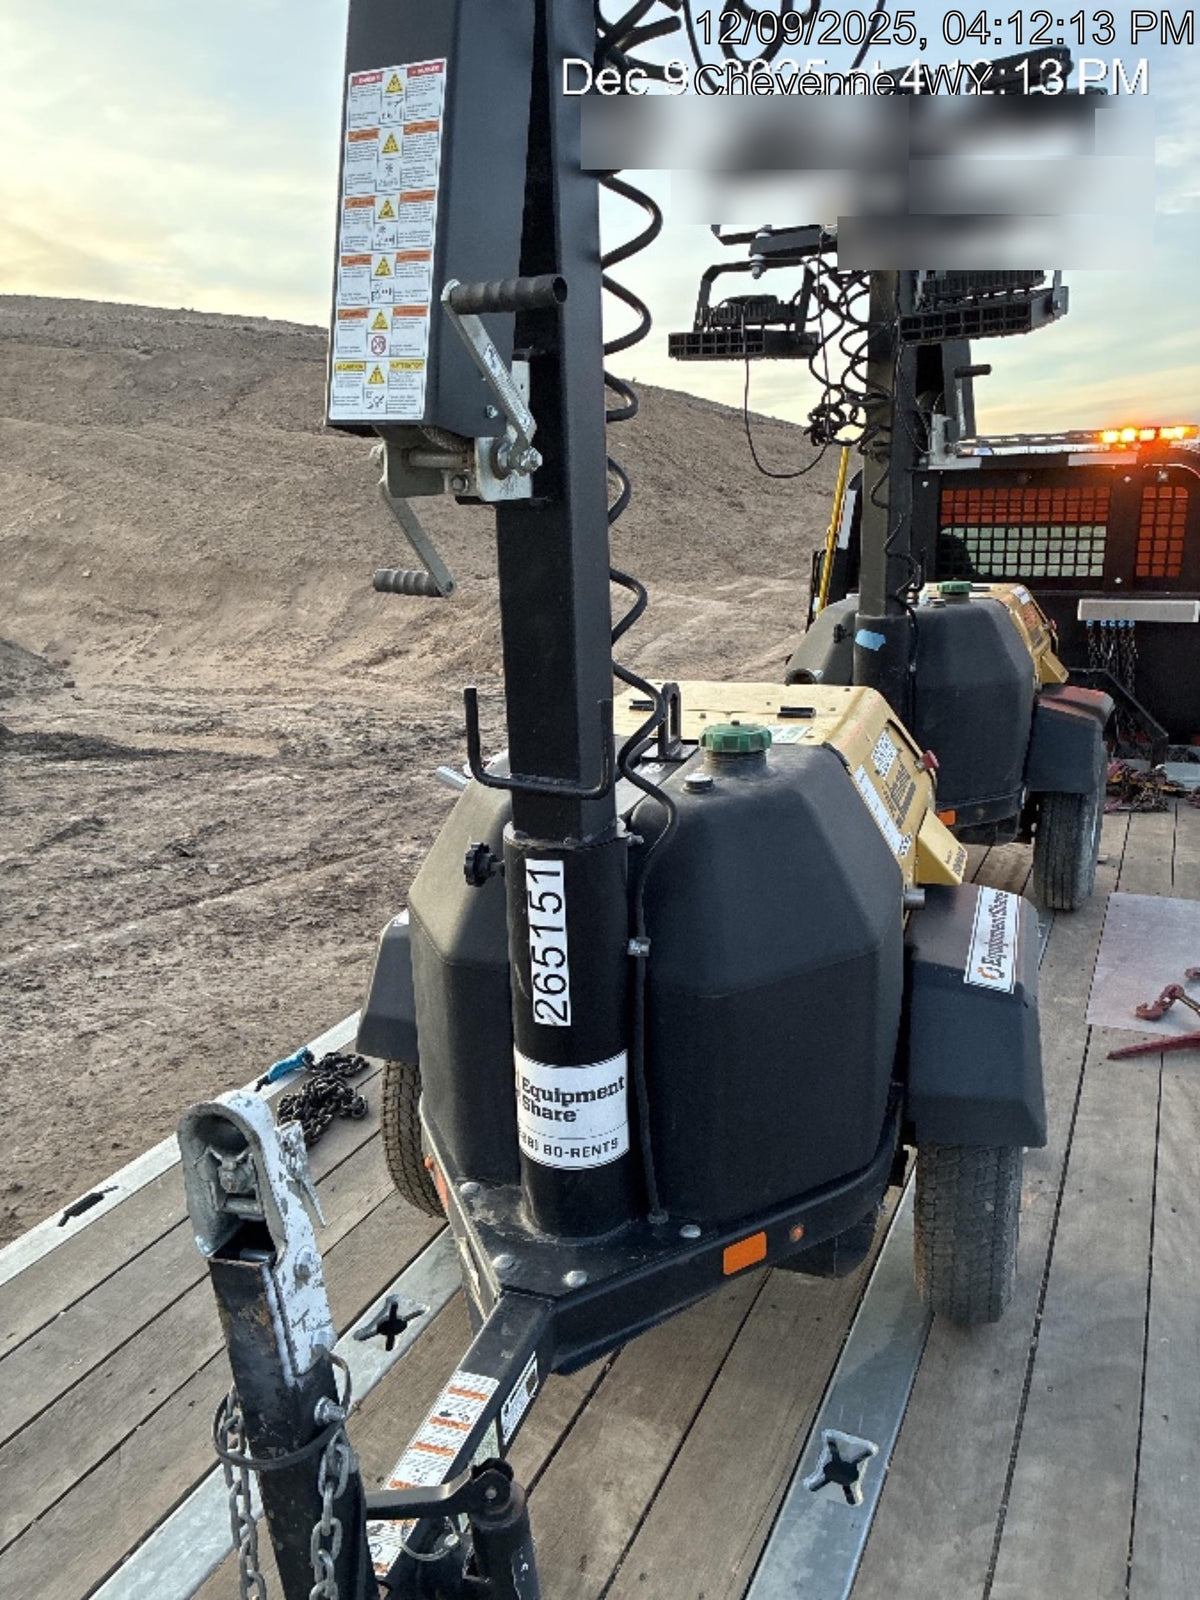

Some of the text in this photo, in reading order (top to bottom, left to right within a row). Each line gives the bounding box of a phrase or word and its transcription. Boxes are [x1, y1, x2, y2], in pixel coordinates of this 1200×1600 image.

[527, 869, 567, 1022] 265151
[521, 1075, 625, 1107] Equipment
[543, 1137, 618, 1158] 80-RENTS
